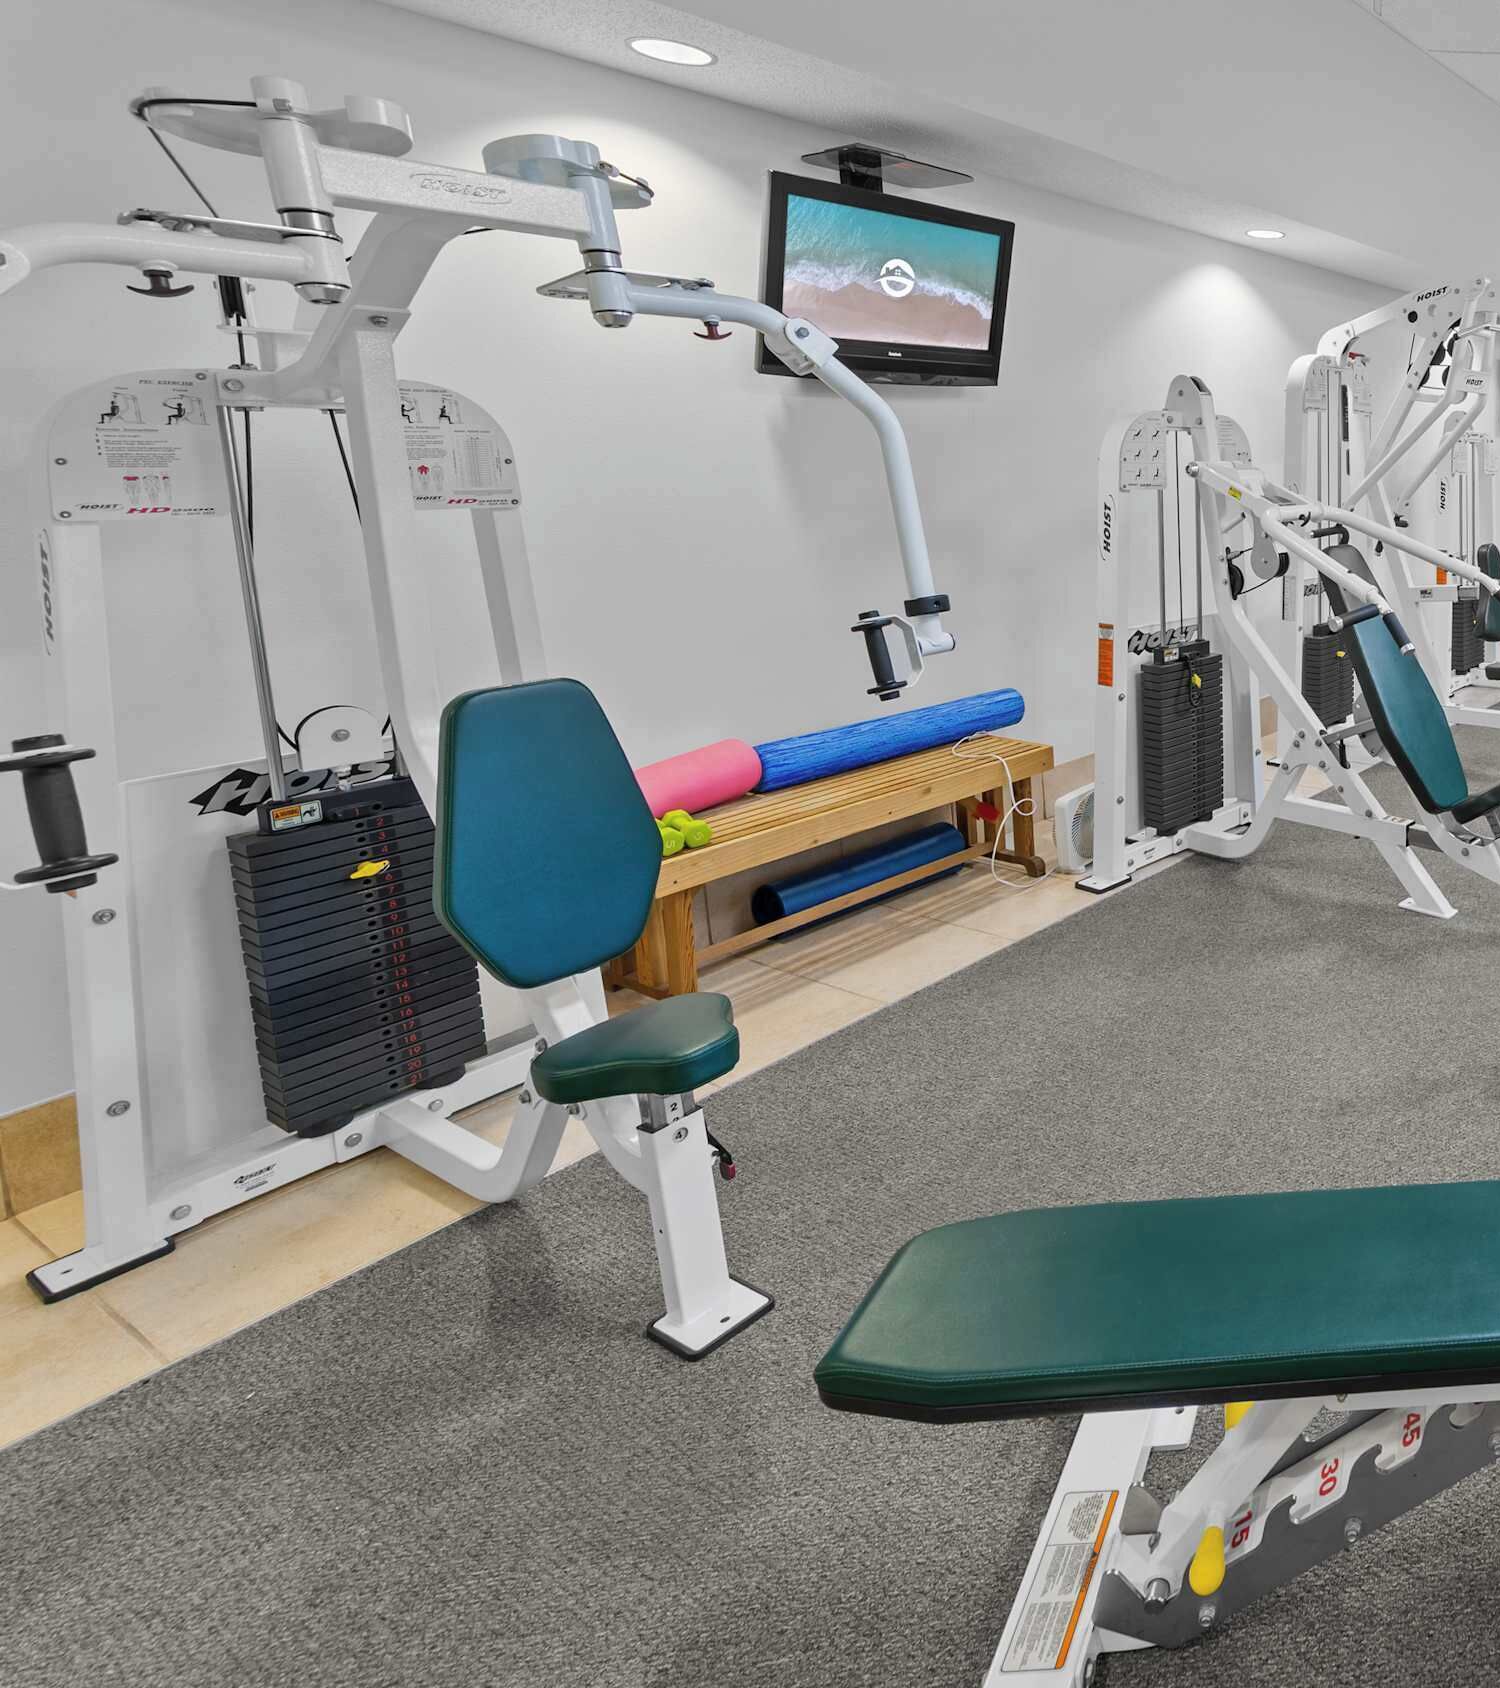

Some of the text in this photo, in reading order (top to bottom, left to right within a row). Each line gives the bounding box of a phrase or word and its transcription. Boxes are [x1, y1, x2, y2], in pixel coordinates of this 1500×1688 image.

[1416, 285, 1448, 302] HOIST
[1439, 481, 1447, 510] HOIST
[1102, 501, 1112, 553] HOIST
[670, 1102, 678, 1113] 2
[1402, 1412, 1422, 1448] 45
[1318, 1457, 1340, 1497] 30
[1230, 1509, 1253, 1549] 15
